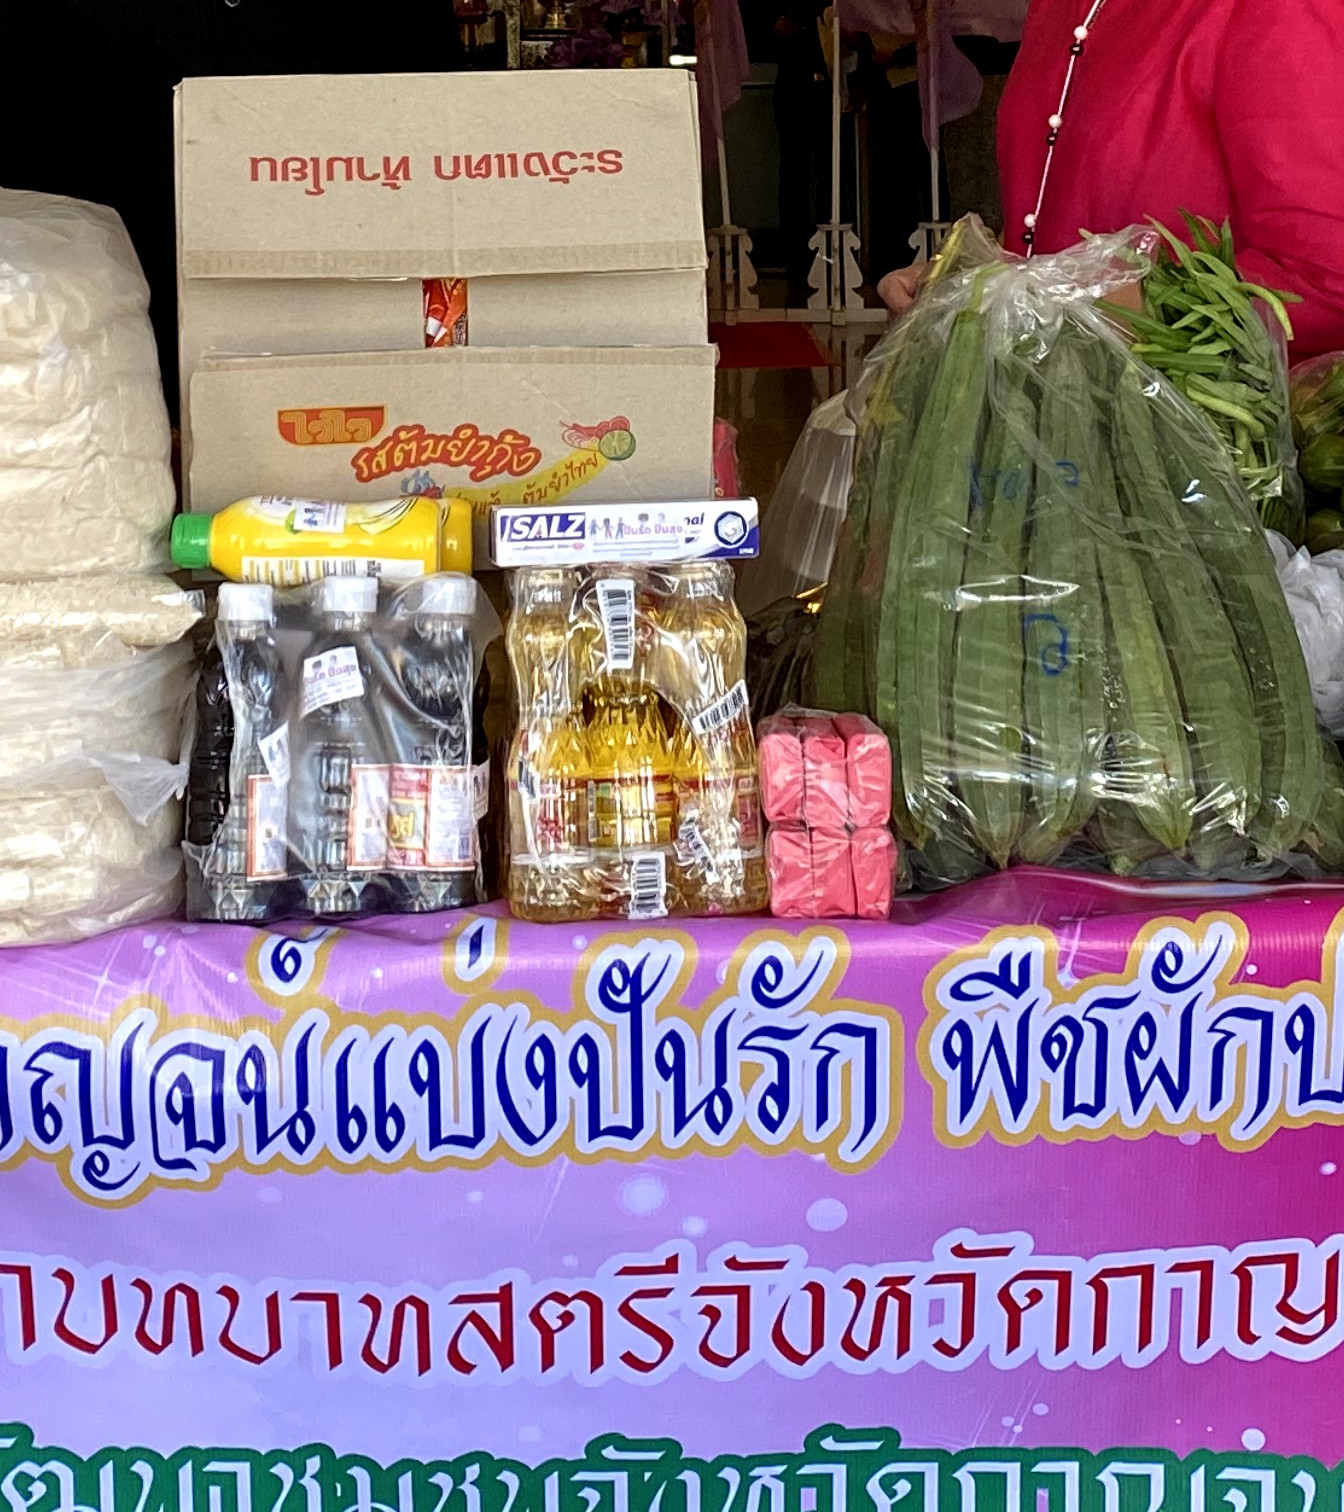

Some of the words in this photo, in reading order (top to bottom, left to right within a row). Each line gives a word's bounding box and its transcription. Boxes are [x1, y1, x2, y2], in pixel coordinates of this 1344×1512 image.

[249, 154, 412, 196] ห้ามโยน
[434, 149, 623, 185] ระวังแตก
[280, 408, 373, 443] ไวไว
[357, 427, 537, 479] รสต้มยำกุ้ง
[509, 513, 586, 540] SALZ
